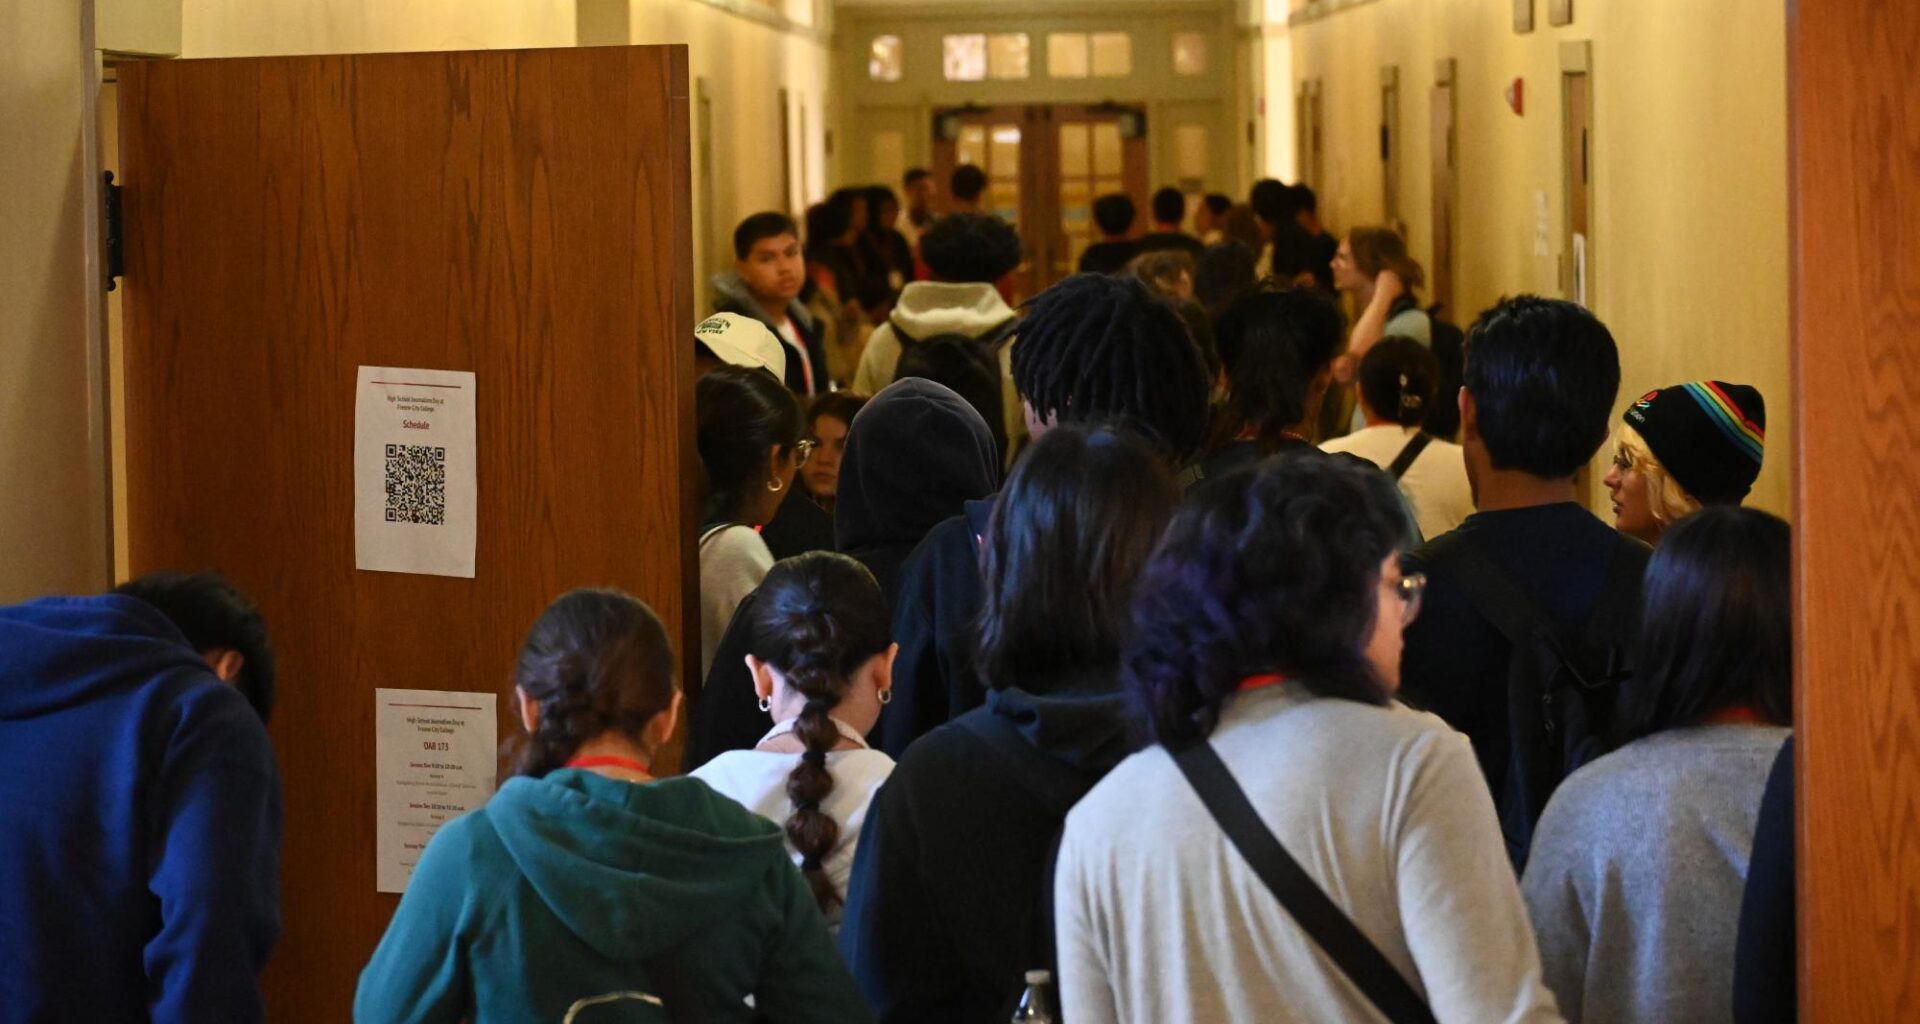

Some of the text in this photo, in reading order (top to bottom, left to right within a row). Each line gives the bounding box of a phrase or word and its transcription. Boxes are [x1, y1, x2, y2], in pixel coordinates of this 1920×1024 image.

[411, 404, 419, 412] City
[420, 405, 434, 413] College
[403, 419, 430, 430] Schedule
[432, 726, 440, 734] City
[440, 726, 455, 735] College
[437, 742, 449, 751] 173
